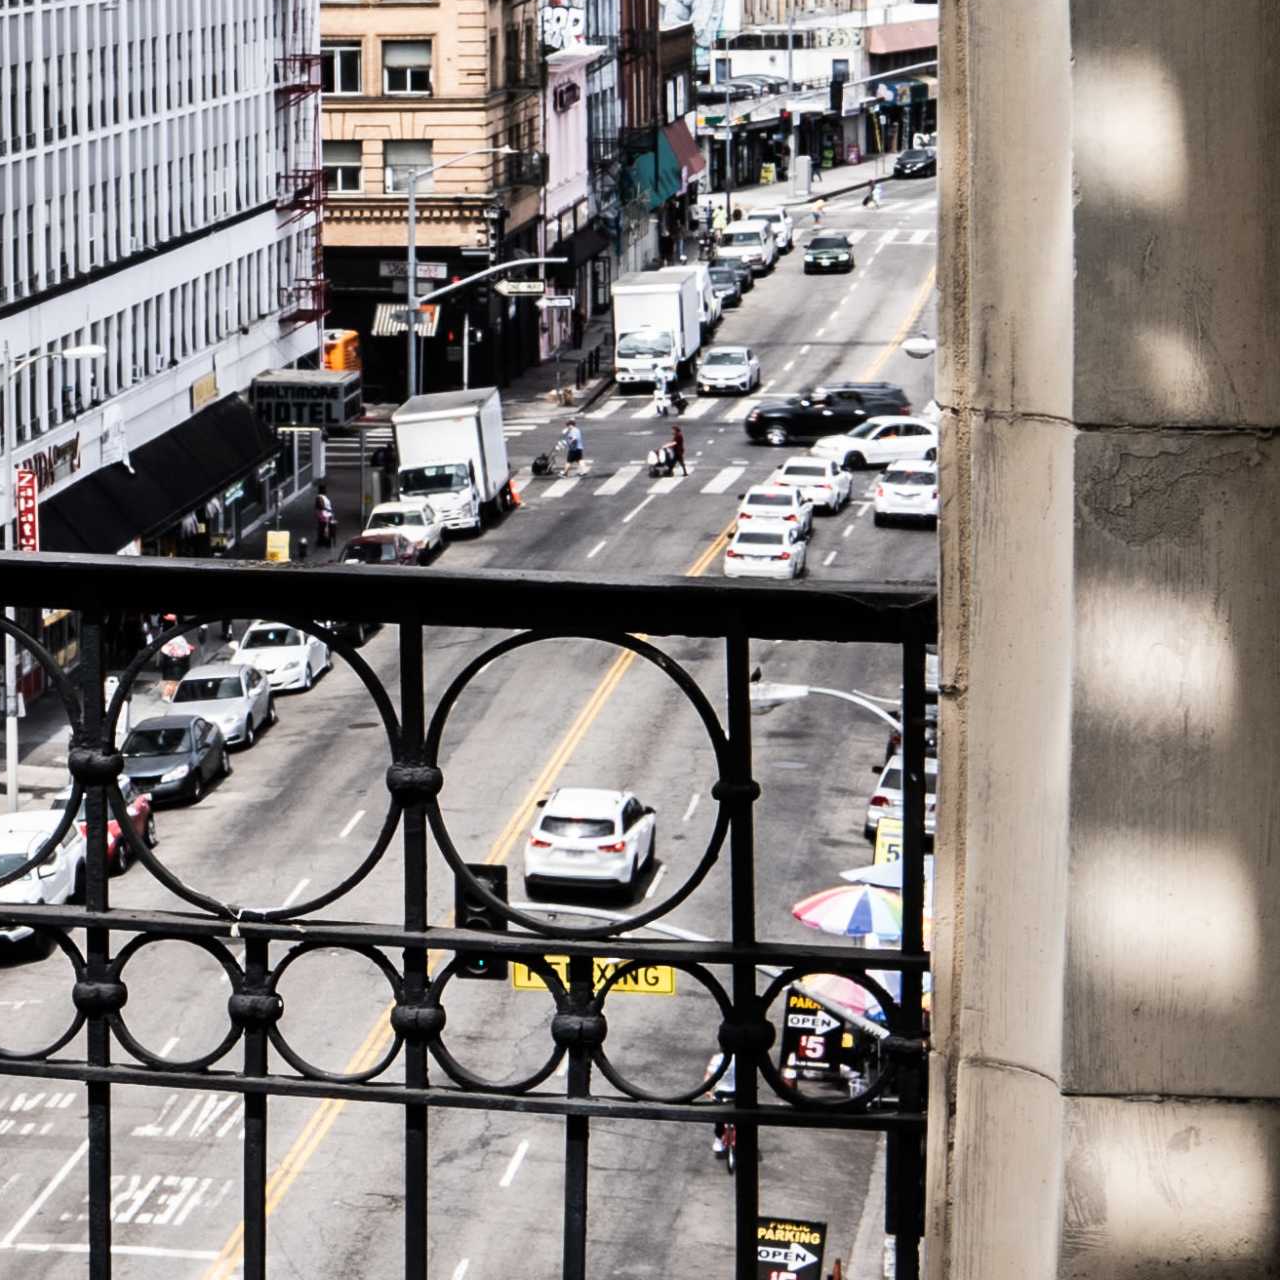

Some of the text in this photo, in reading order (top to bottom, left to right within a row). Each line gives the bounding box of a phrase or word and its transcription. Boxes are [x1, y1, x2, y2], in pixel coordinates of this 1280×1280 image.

[257, 385, 338, 399] BALTIMORE
[257, 401, 338, 422] HOTEL
[790, 1016, 831, 1027] OPEN
[757, 1227, 821, 1245] PARKING
[758, 1249, 807, 1262] OPEN
